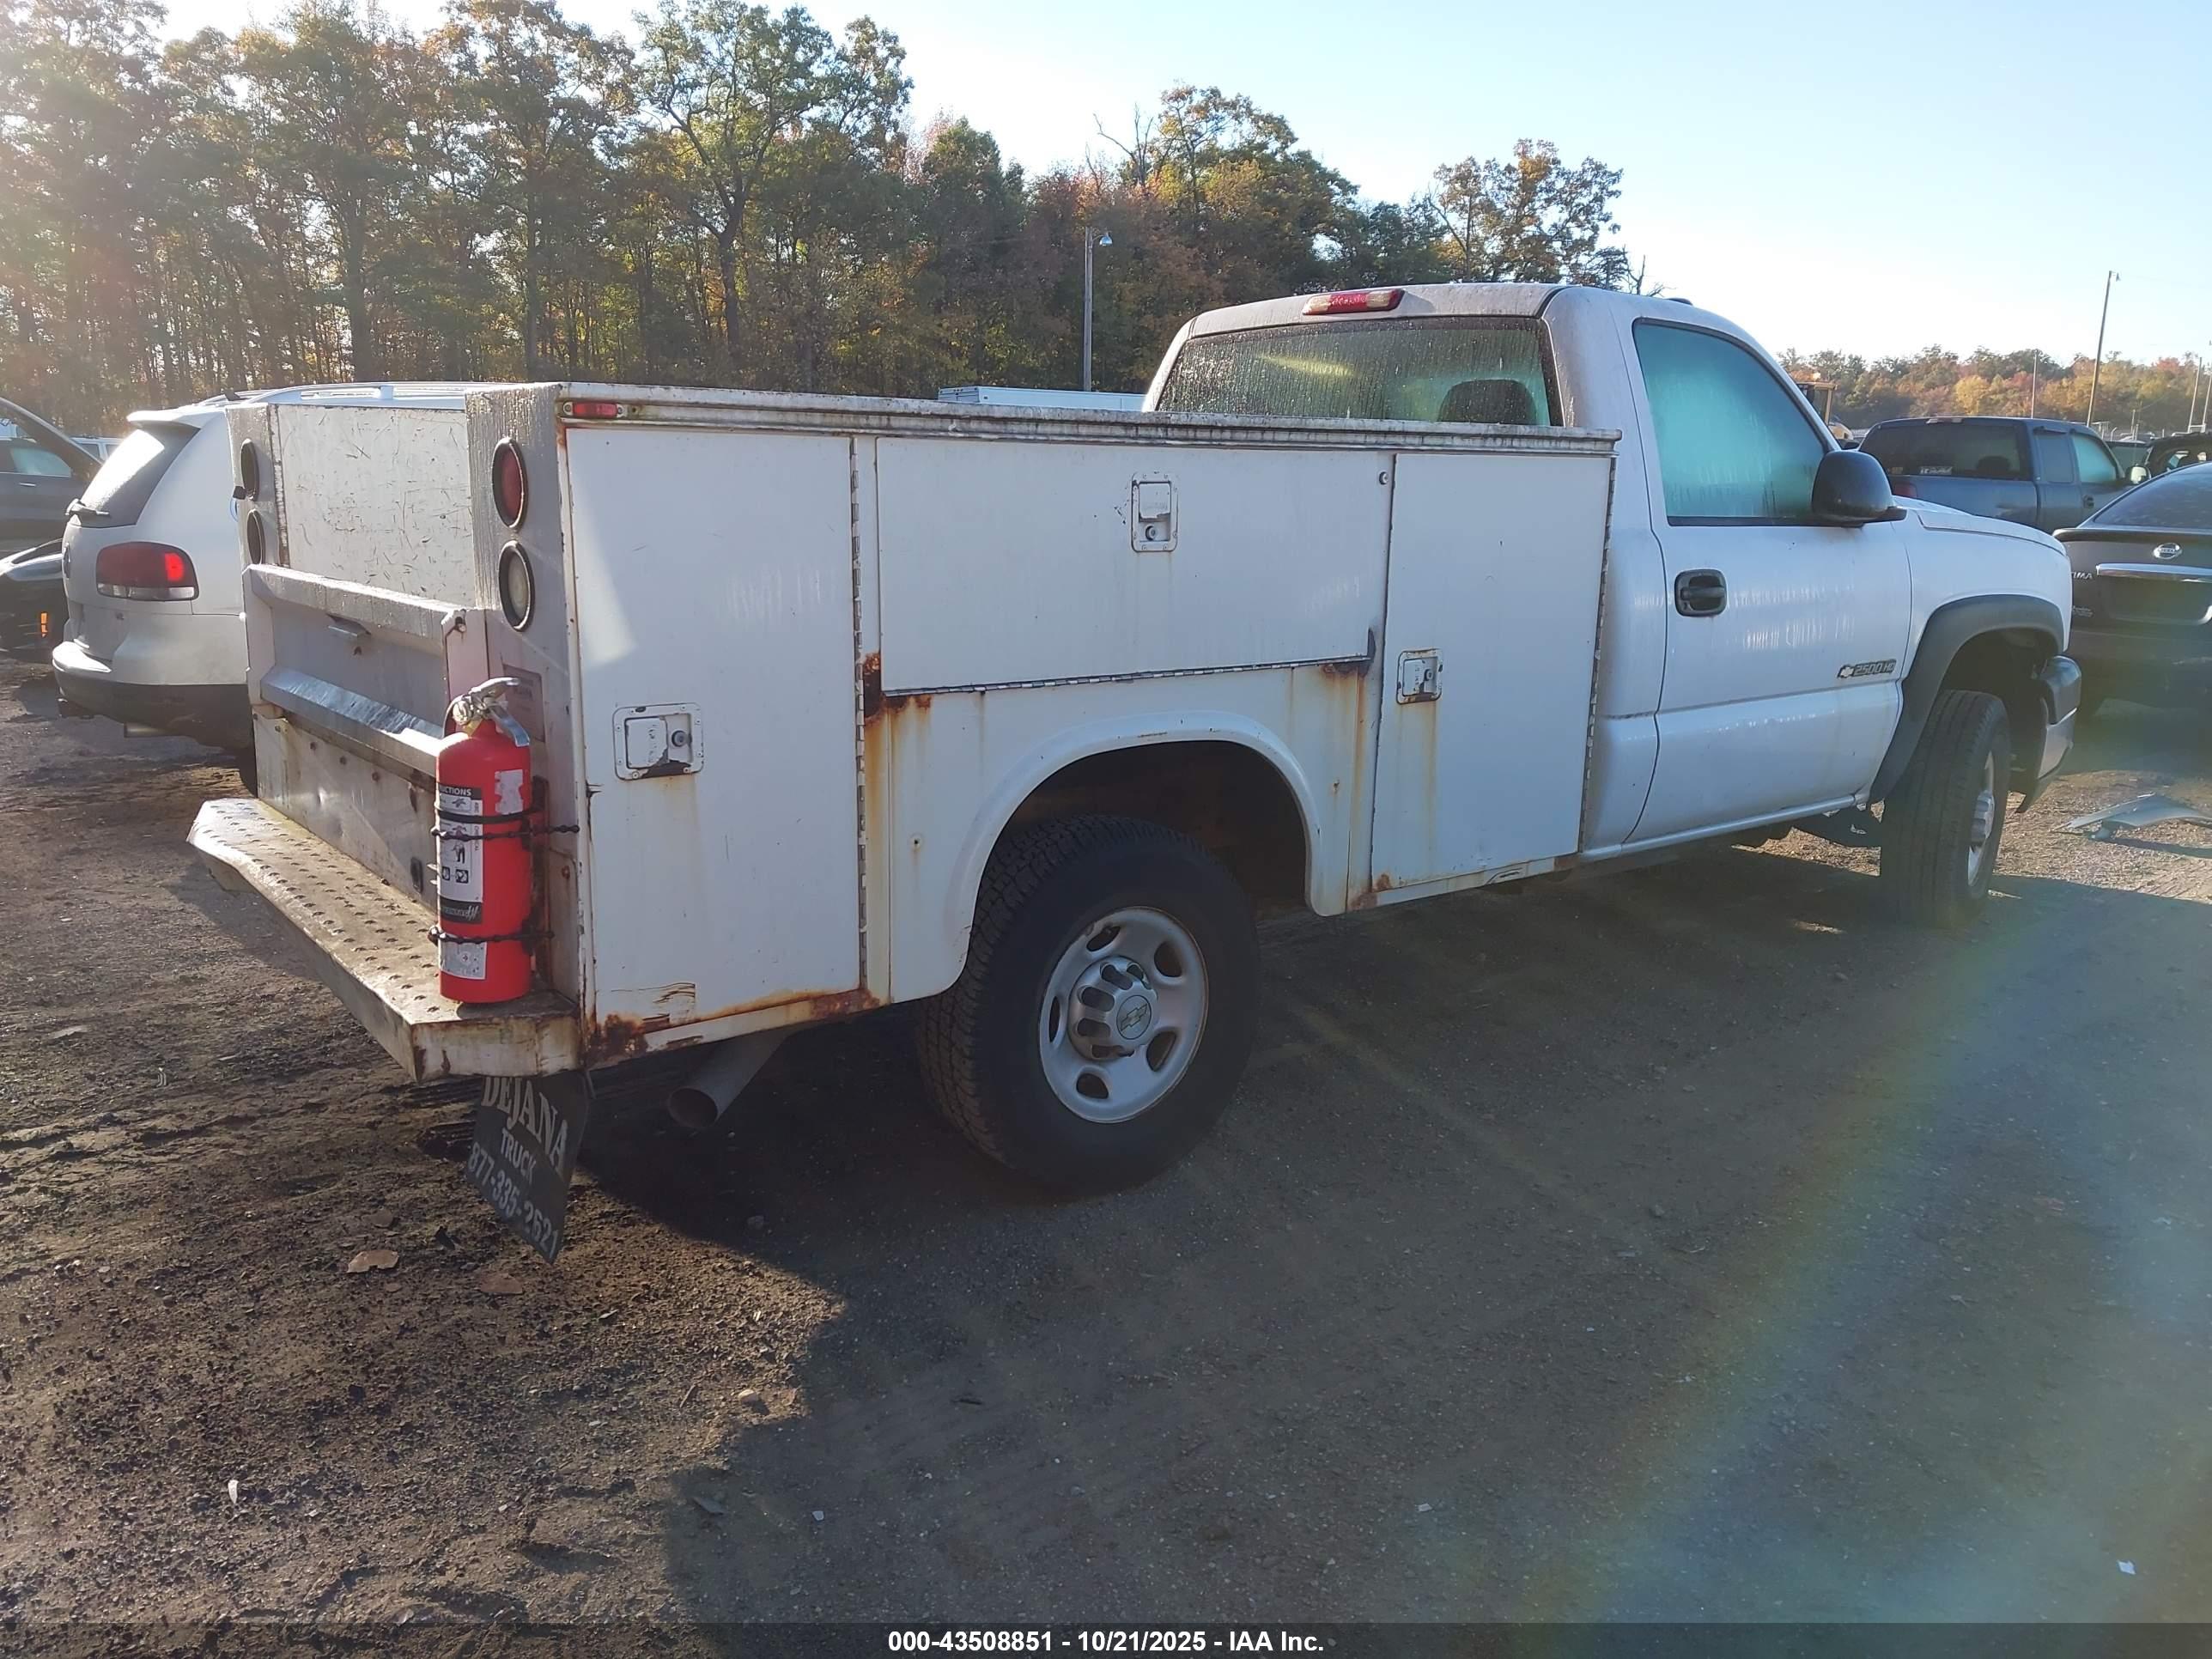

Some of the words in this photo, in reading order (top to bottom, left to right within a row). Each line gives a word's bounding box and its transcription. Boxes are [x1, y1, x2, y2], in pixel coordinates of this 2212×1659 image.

[1854, 662, 1882, 676] 2500
[481, 1077, 568, 1182] DEJANA
[501, 1127, 537, 1185] TRUCK
